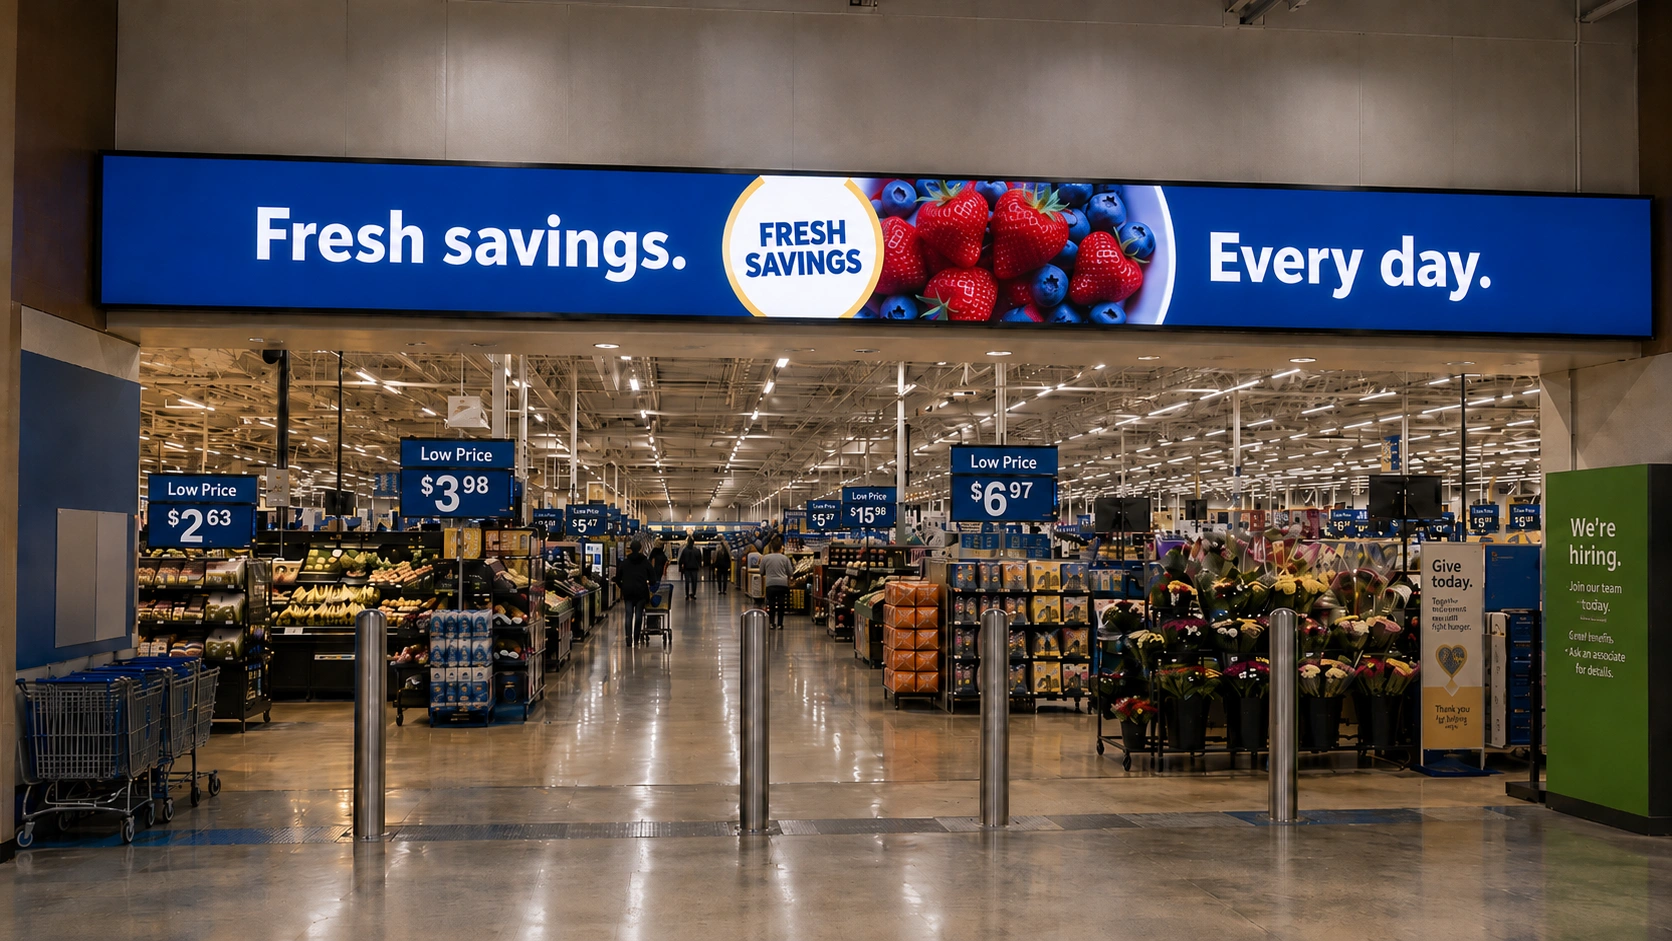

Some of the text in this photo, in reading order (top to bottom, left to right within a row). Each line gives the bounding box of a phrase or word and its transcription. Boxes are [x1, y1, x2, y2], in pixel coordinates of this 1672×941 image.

[256, 207, 687, 283] Fresh savings.
[745, 219, 863, 278] FRESH SAVINGS
[1210, 231, 1492, 302] Every day.
[421, 446, 493, 462] Low Price
[971, 454, 1037, 469] Low Price
[168, 481, 238, 497] Low Price
[868, 492, 887, 502] Price
[1570, 517, 1616, 538] We're
[1432, 559, 1462, 573] Give
[1569, 544, 1622, 572] hiring.
[1431, 575, 1473, 591] today.
[1569, 581, 1623, 594] Join our team
[1581, 599, 1611, 614] today.
[1569, 647, 1626, 663] Ask an associate
[1575, 662, 1587, 675] for
[1457, 706, 1471, 714] you
